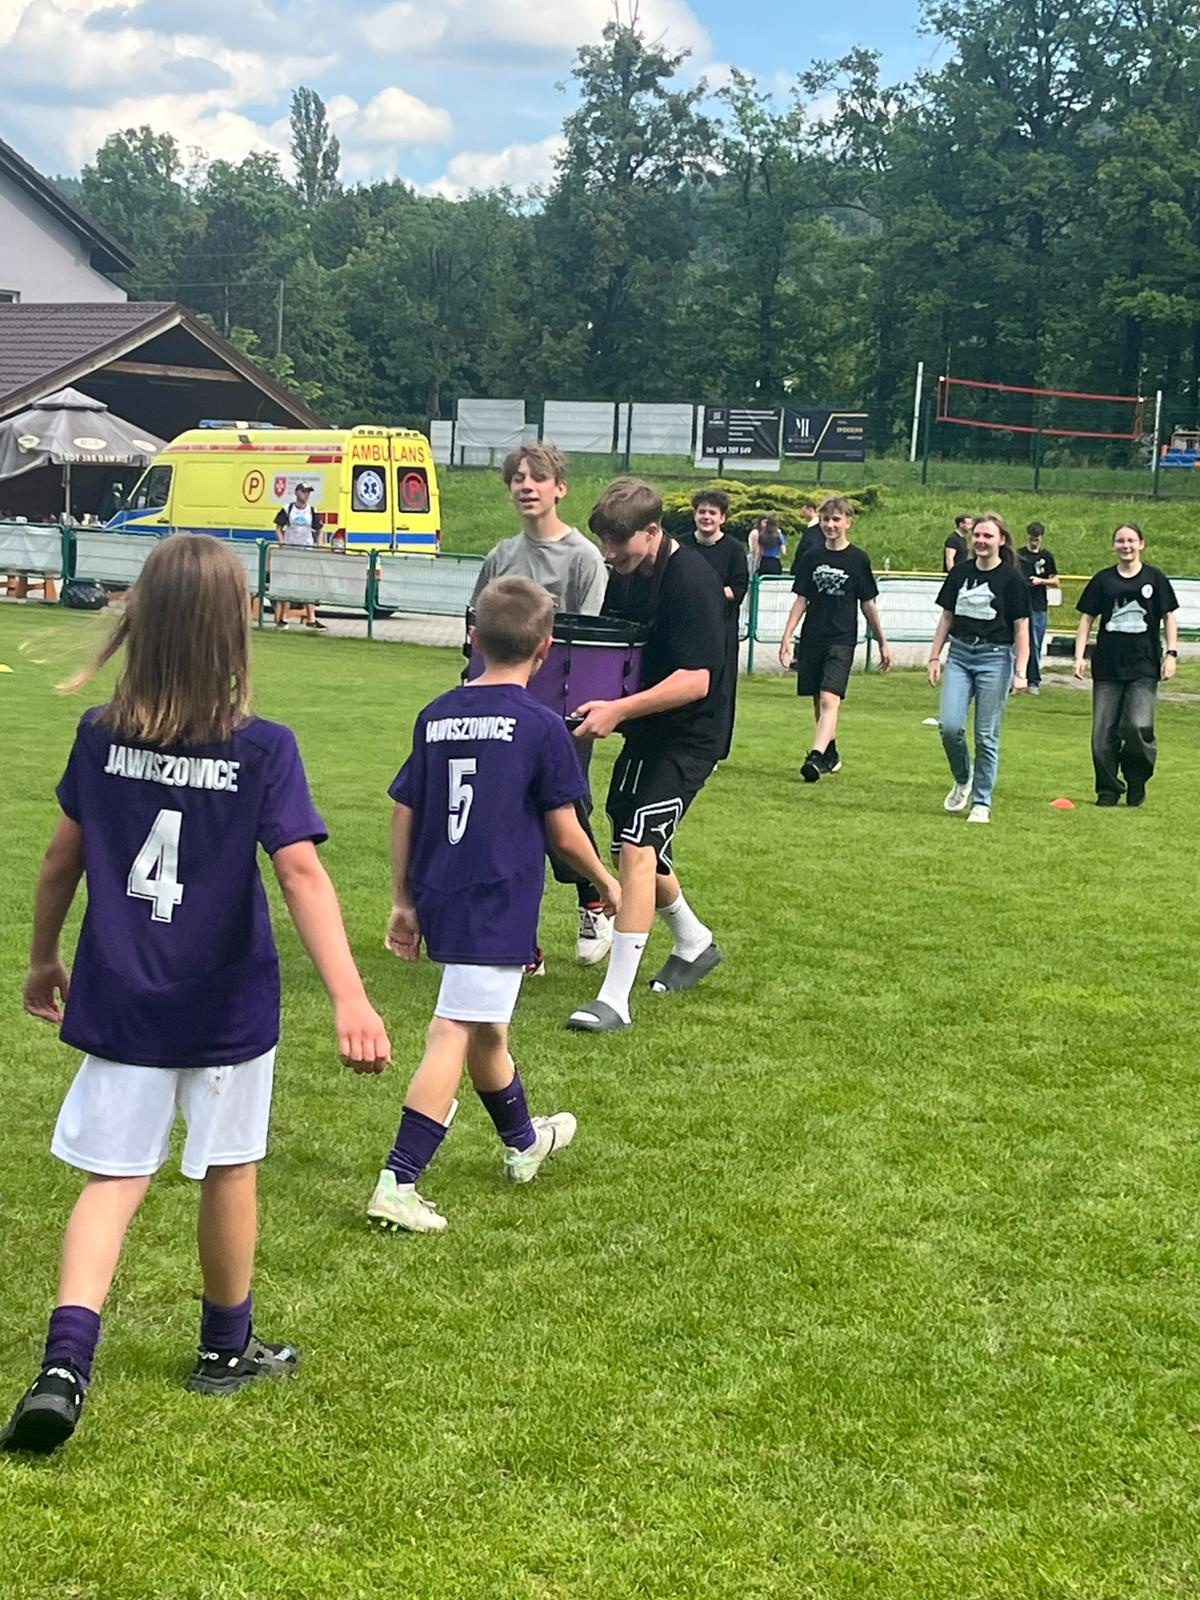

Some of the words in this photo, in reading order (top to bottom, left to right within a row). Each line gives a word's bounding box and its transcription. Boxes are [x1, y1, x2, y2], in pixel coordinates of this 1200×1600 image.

[352, 444, 425, 463] AMBULANS
[249, 477, 260, 495] P
[104, 744, 240, 792] JAWISZOWICE
[447, 758, 477, 845] 5
[126, 809, 184, 923] 4
